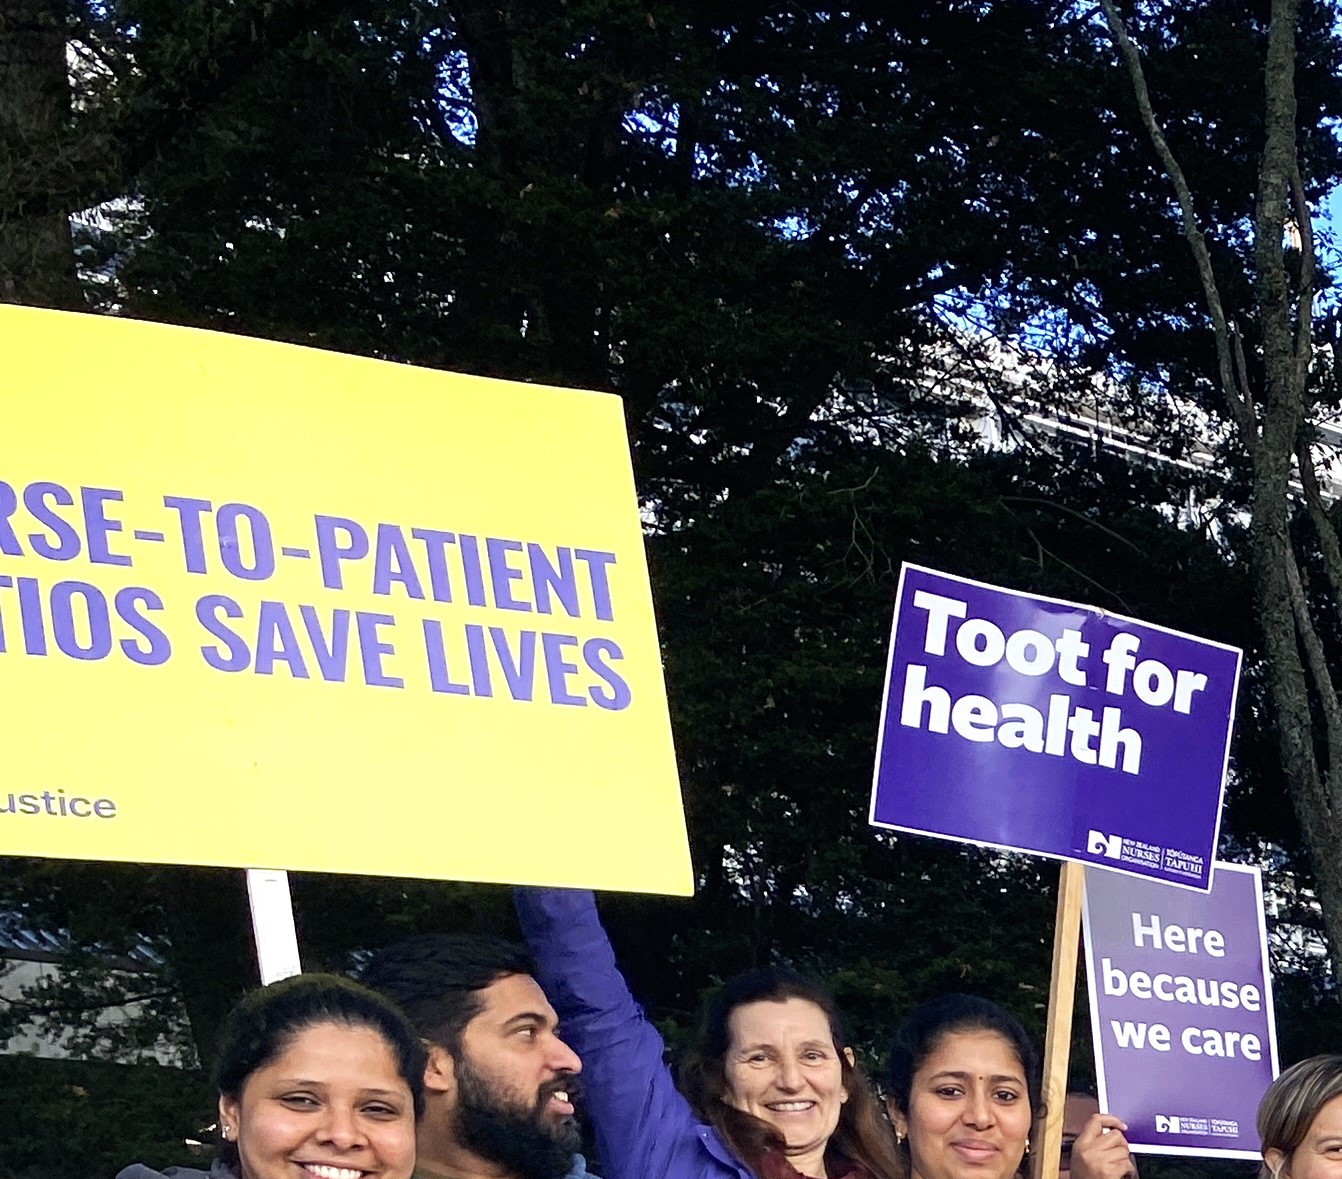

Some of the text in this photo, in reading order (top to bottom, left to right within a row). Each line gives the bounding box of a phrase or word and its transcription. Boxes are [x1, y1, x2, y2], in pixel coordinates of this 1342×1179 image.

[0, 480, 617, 622] SE-TO-PATIENT
[0, 575, 632, 711] IOS SAVE LIVES
[914, 590, 1208, 715] Toot for
[900, 664, 1142, 776] health
[0, 788, 117, 819] ustice
[1121, 845, 1160, 862] NURSES
[1132, 912, 1225, 957] Here
[1102, 958, 1261, 1012] because
[1110, 1020, 1262, 1062] we care
